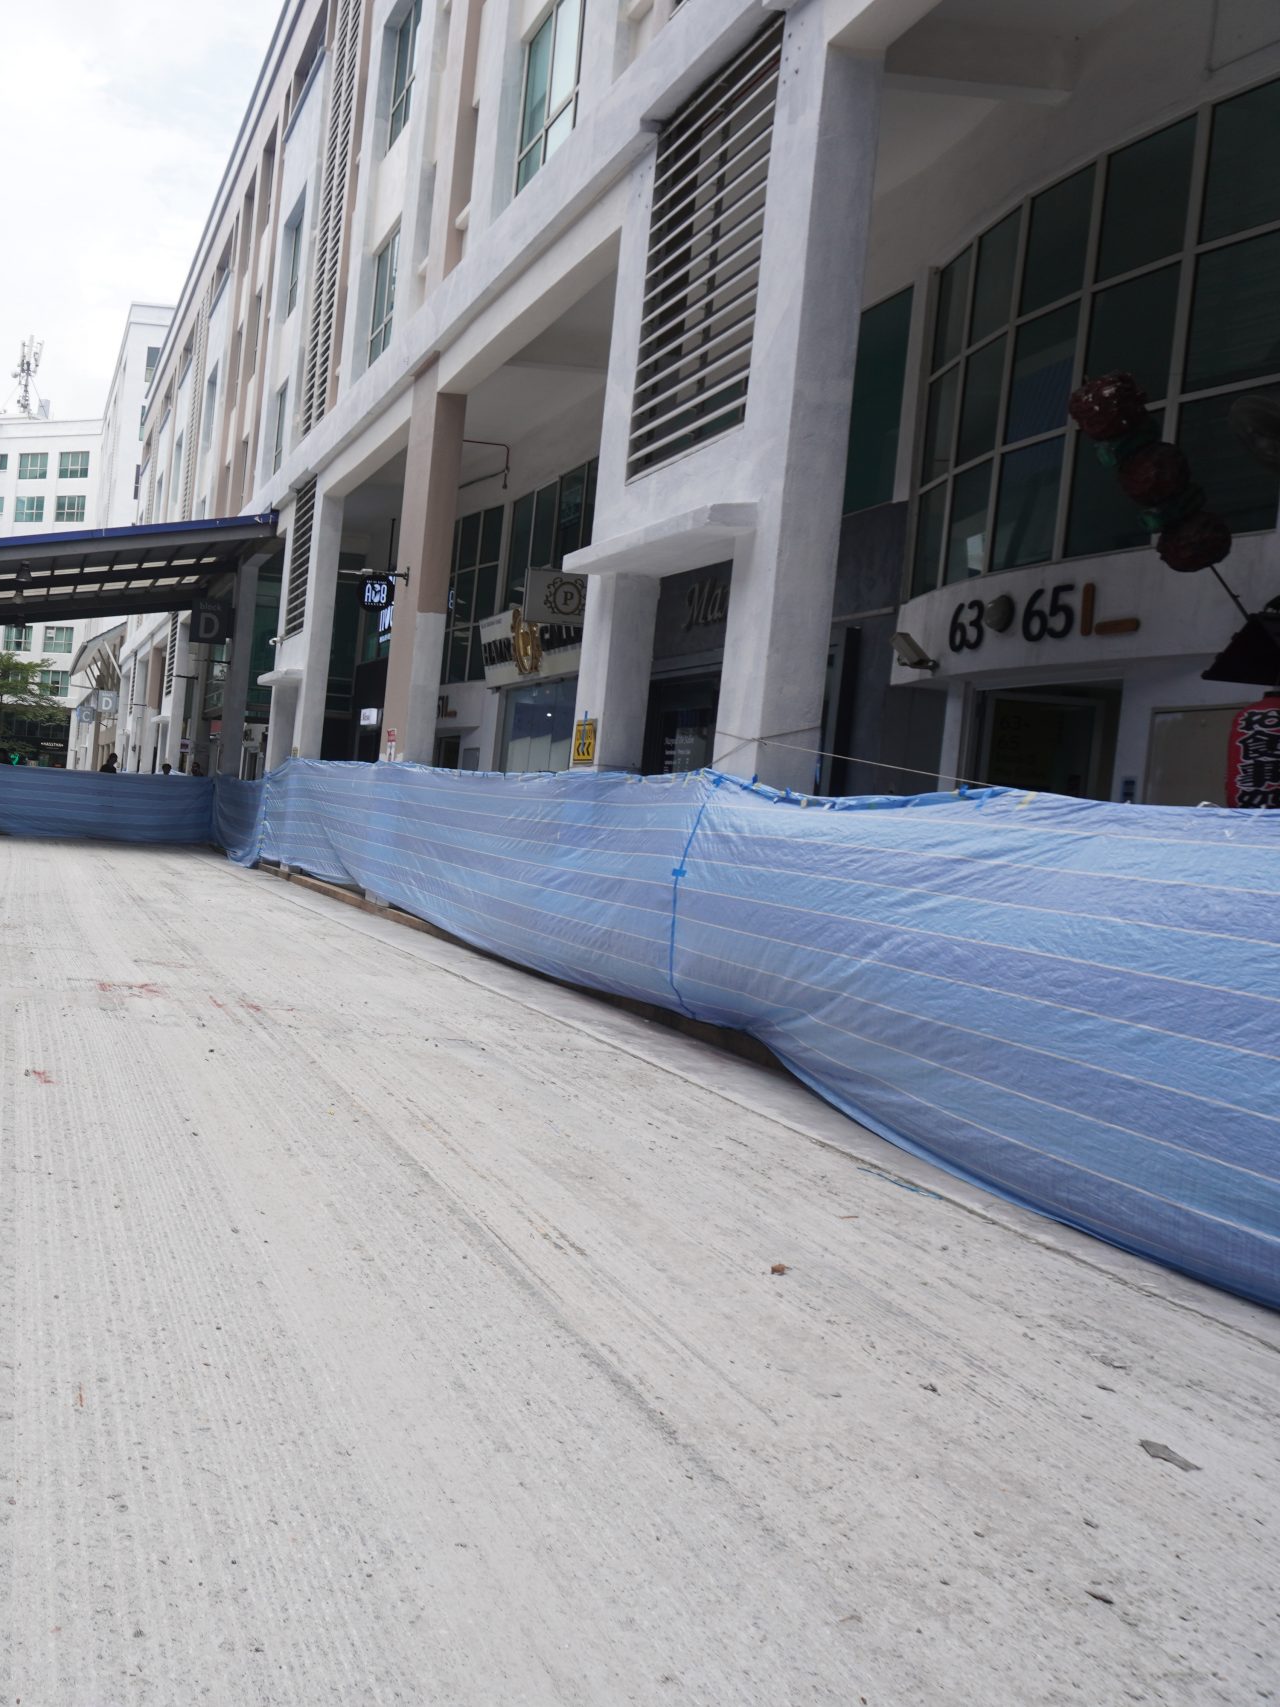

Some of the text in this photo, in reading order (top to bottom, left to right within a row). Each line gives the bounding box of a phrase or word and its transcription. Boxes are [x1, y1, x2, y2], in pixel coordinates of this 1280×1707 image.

[198, 612, 220, 639] D
[102, 697, 112, 710] D
[82, 711, 91, 721] C
